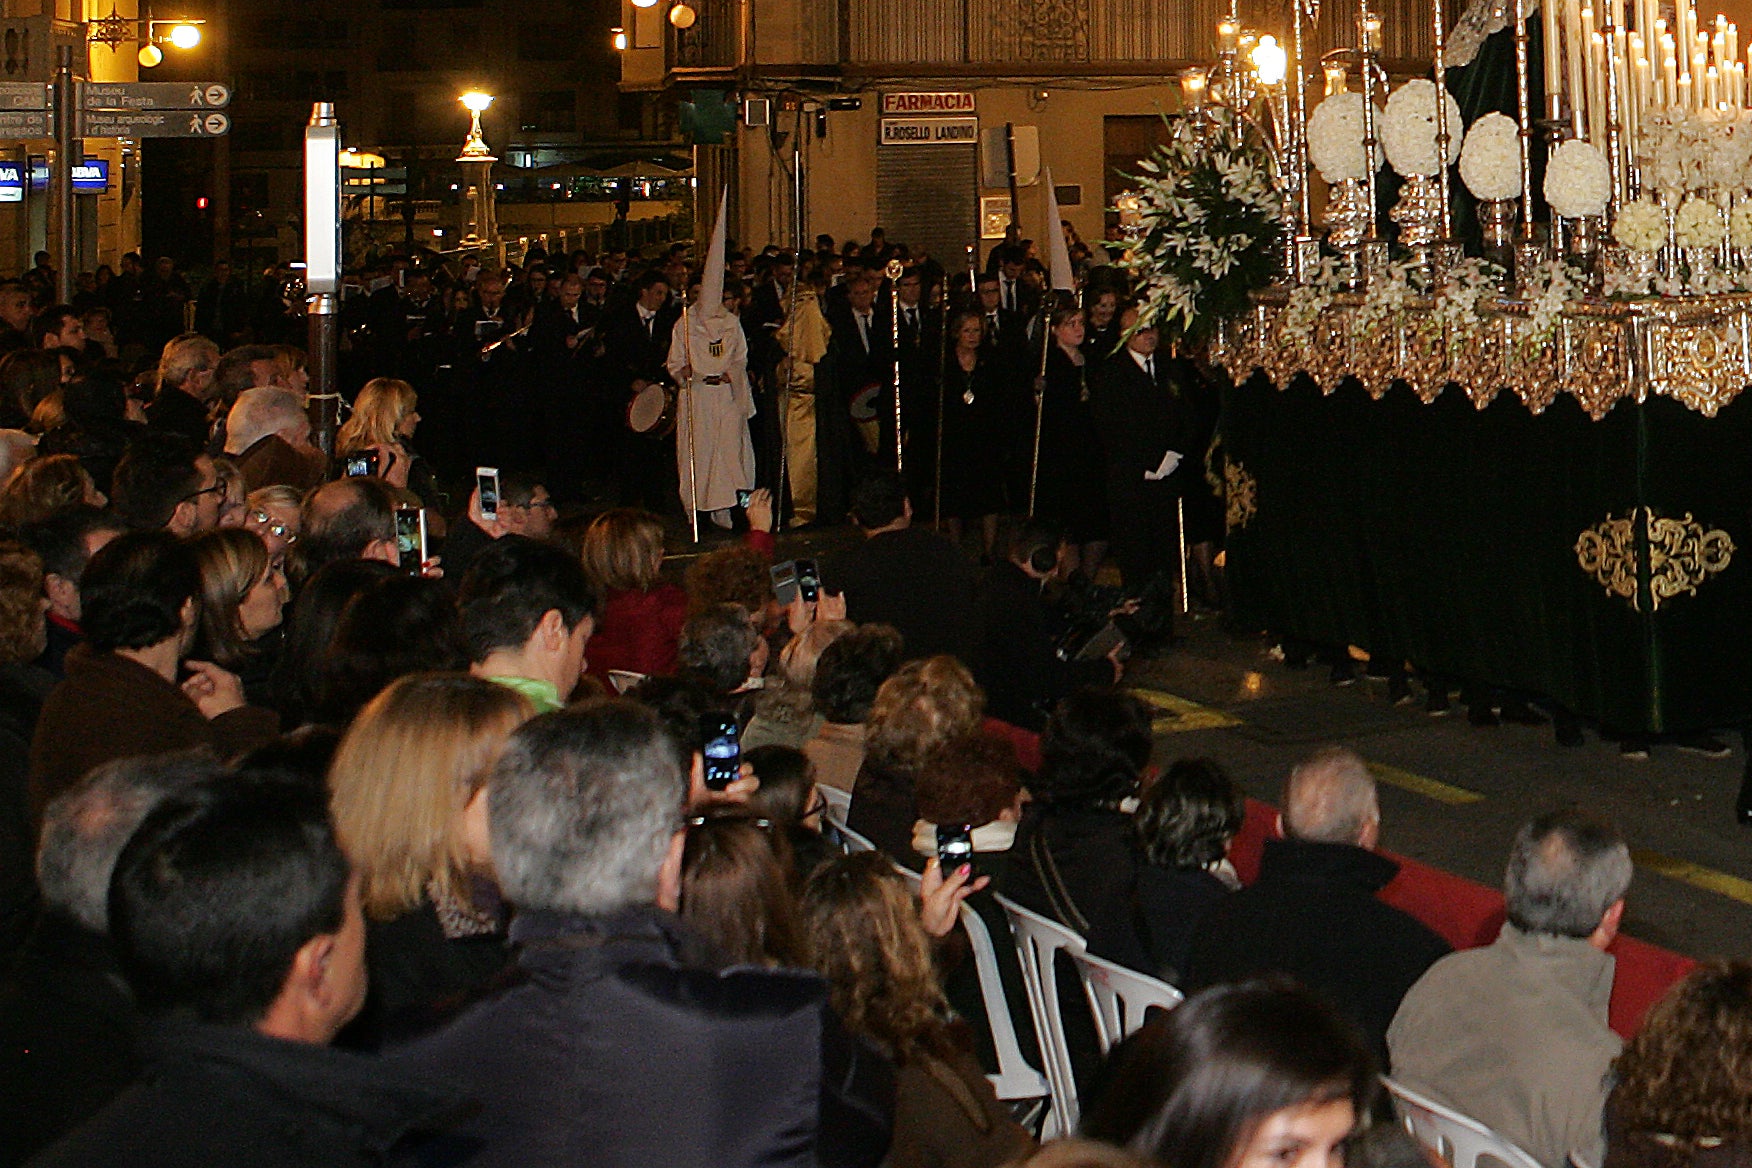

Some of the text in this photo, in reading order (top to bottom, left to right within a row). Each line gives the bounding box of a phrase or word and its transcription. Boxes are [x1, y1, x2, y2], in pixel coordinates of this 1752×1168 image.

[85, 86, 125, 95] Museu
[121, 96, 154, 107] Festa
[885, 94, 973, 111] FARMACIA
